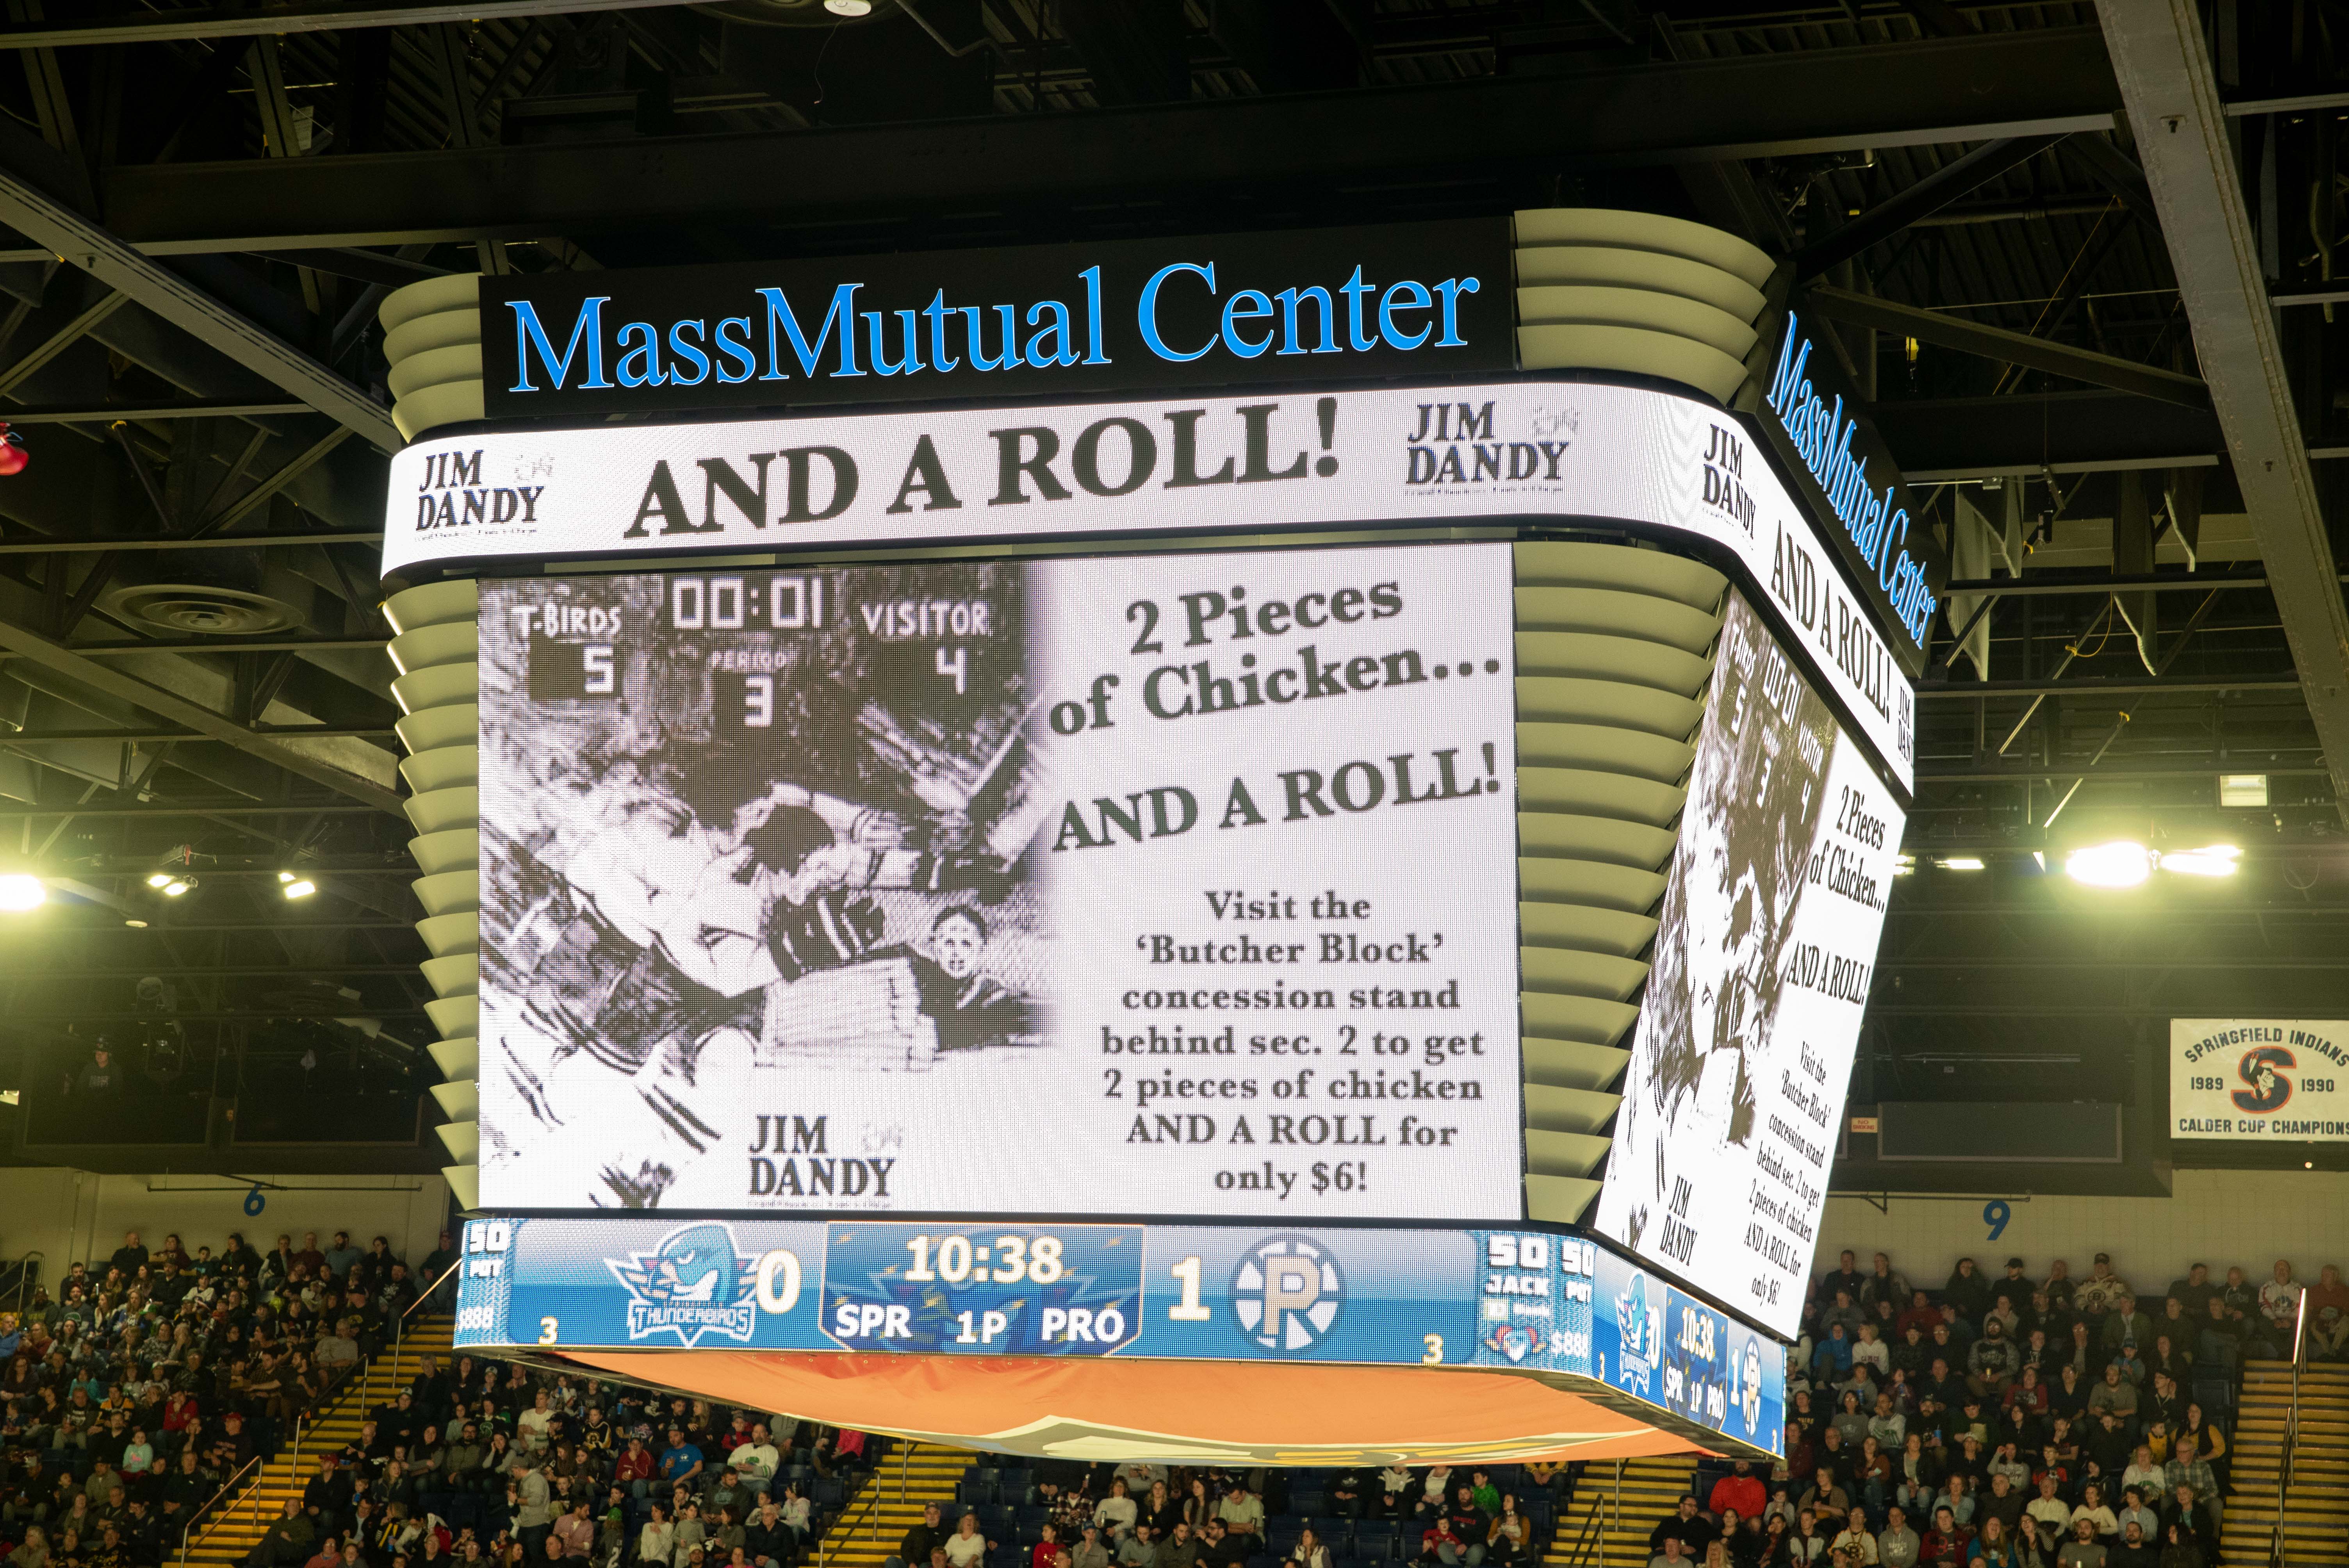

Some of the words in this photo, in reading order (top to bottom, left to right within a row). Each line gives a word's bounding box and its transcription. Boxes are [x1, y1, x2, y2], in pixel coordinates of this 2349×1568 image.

[505, 266, 1112, 392] MassMutual
[1138, 261, 1480, 362] Center
[1407, 401, 1495, 443] JIM
[419, 449, 484, 493] JIM
[624, 445, 859, 540] AND
[886, 434, 963, 515] A
[987, 397, 1340, 506] ROLL!
[1406, 442, 1569, 485] DANDY
[1704, 424, 1742, 480] JIM
[1766, 310, 1895, 571] MassMutual
[1878, 509, 1936, 649] Center
[416, 486, 544, 531] DANDY
[1702, 464, 1756, 540] DANDY
[673, 578, 822, 628] 00:01
[860, 600, 990, 637] VISITOR
[1126, 600, 1163, 655] 2
[1179, 582, 1403, 647] Pieces
[1771, 520, 1816, 631] AND
[1820, 579, 1832, 657] A
[1837, 595, 1890, 724] ROLL!
[585, 646, 614, 692] 5
[937, 648, 966, 695] 4
[1049, 674, 1120, 734] of
[1143, 645, 1499, 720] Chicken...
[1763, 644, 1800, 730] 00:01
[745, 677, 773, 727] 3
[1731, 684, 1747, 736] 5
[1898, 686, 1910, 729] JIM
[1798, 721, 1823, 780] VISITOR
[1053, 786, 1198, 852] AND
[1219, 777, 1267, 829] A
[1278, 742, 1499, 821] ROLL!
[1757, 757, 1772, 808] 3
[1801, 779, 1812, 825] 4
[1836, 784, 1849, 833] 2
[1846, 789, 1886, 850] Pieces
[1809, 839, 1830, 885] of
[1828, 845, 1884, 913] Chicken...
[1204, 890, 1297, 920] Visit
[1310, 889, 1372, 920] the
[1121, 979, 1335, 1009] concession
[1349, 979, 1461, 1009] stand
[1786, 940, 1820, 989] AND
[1817, 951, 1830, 993] A
[1828, 955, 1870, 1006] ROLL!
[1101, 1025, 1236, 1055] behind
[1249, 1034, 1321, 1055] sec.
[1338, 1025, 1358, 1055] 2
[1373, 1032, 1410, 1055] to
[1424, 1031, 1485, 1066] get
[1800, 1041, 1816, 1076] Visit
[1815, 1058, 1826, 1086] the
[2185, 1028, 2283, 1063] SPRINGFIELD
[2289, 1030, 2349, 1067] INDIANS
[1104, 1068, 1122, 1098] 2
[1137, 1068, 1258, 1107] pieces
[1272, 1069, 1315, 1099] of
[1328, 1069, 1483, 1099] chicken
[2191, 1076, 2224, 1090] 1989
[2301, 1078, 2335, 1092] 1990
[750, 1115, 828, 1153] JIM
[1126, 1114, 1216, 1144] AND
[1229, 1114, 1255, 1144] A
[1269, 1114, 1386, 1145] ROLL
[1399, 1115, 1458, 1146] for
[1769, 1114, 1805, 1155] concession
[1805, 1142, 1825, 1169] stand
[2179, 1118, 2232, 1133] CALDER
[2238, 1119, 2266, 1133] CUP
[750, 1158, 896, 1197] DANDY
[1214, 1161, 1297, 1200] only
[1311, 1161, 1367, 1196] $6!
[1668, 1173, 1693, 1219] JIM
[1749, 1178, 1756, 1204] 2
[1757, 1140, 1783, 1180] behind
[1795, 1170, 1802, 1195] 2
[1800, 1178, 1808, 1200] to
[1807, 1188, 1820, 1212] get
[244, 1181, 265, 1217] 6
[1752, 1185, 1777, 1219] pieces
[1777, 1201, 1789, 1225] of
[1983, 1199, 2010, 1241] 9
[1659, 1213, 1698, 1267] DANDY
[1786, 1206, 1812, 1243] chicken
[904, 1234, 1064, 1285] 10:38
[1488, 1235, 1549, 1269] 50
[1562, 1241, 1595, 1278] 50
[1744, 1220, 1764, 1253] AND
[1761, 1231, 1769, 1257] A
[1768, 1235, 1790, 1271] ROLL
[1789, 1249, 1801, 1277] for
[756, 1249, 801, 1315] 0
[1169, 1255, 1210, 1322] 1
[1751, 1272, 1768, 1307] only
[1767, 1278, 1780, 1307] $6!
[538, 1316, 558, 1345] 3
[835, 1304, 912, 1340] SPR
[955, 1311, 1006, 1343] 1P
[1042, 1308, 1125, 1343] PRO
[1681, 1305, 1715, 1362] 10:38
[1422, 1333, 1444, 1364] 3
[1665, 1366, 1683, 1402] SPR
[1690, 1381, 1702, 1413] 1P
[1731, 1348, 1740, 1406] 1
[1707, 1384, 1724, 1420] PRO
[1772, 1429, 1777, 1454] 3
